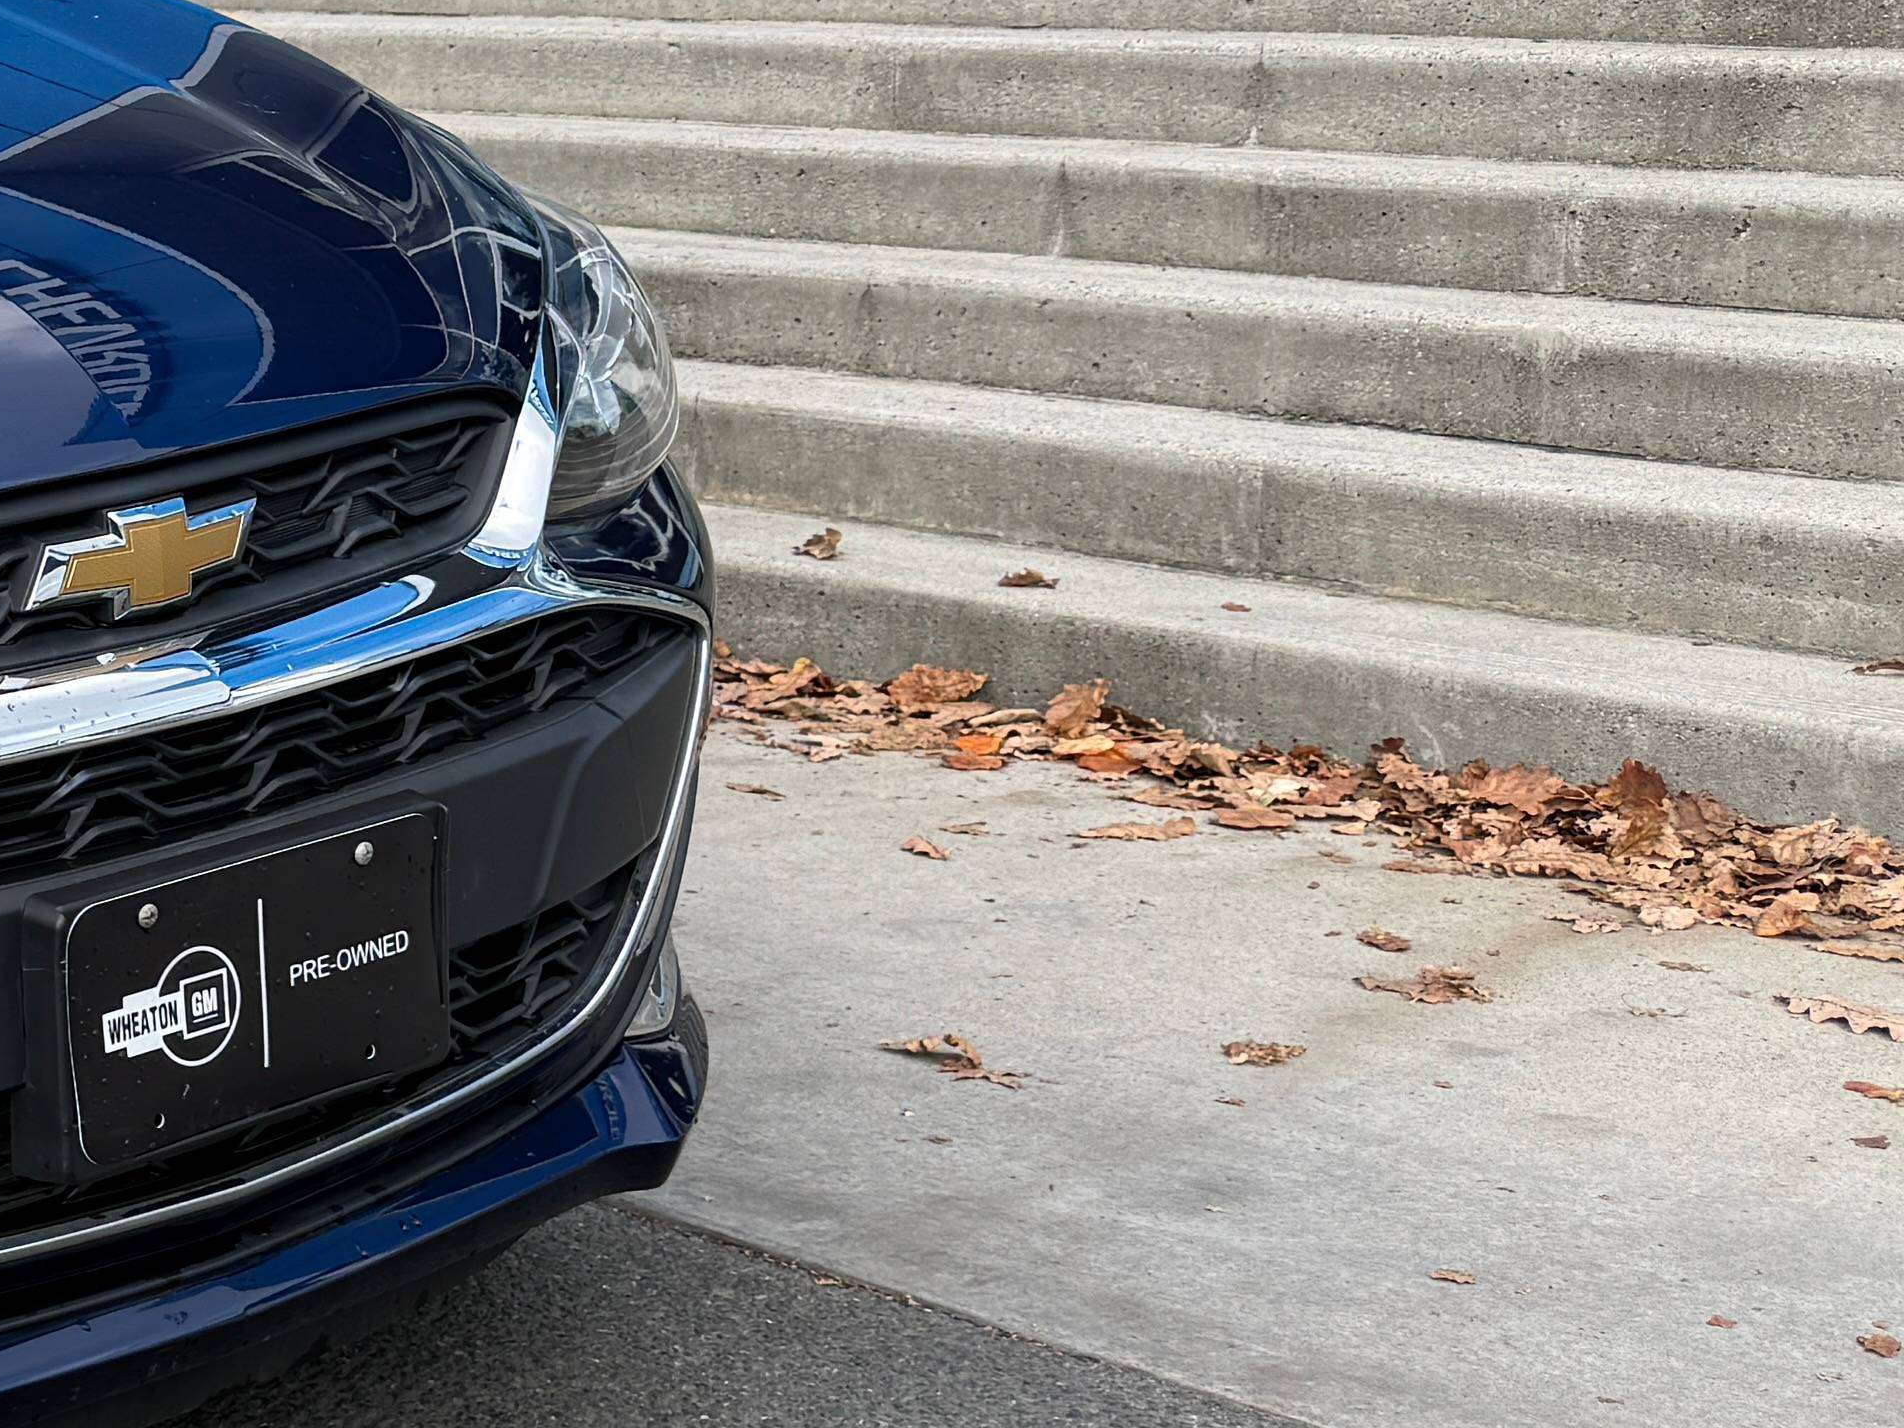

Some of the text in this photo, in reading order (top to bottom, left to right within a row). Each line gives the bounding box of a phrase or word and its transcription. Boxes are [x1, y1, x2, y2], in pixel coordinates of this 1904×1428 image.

[106, 929, 411, 1046] WHEATON GM PRE-OWNED
